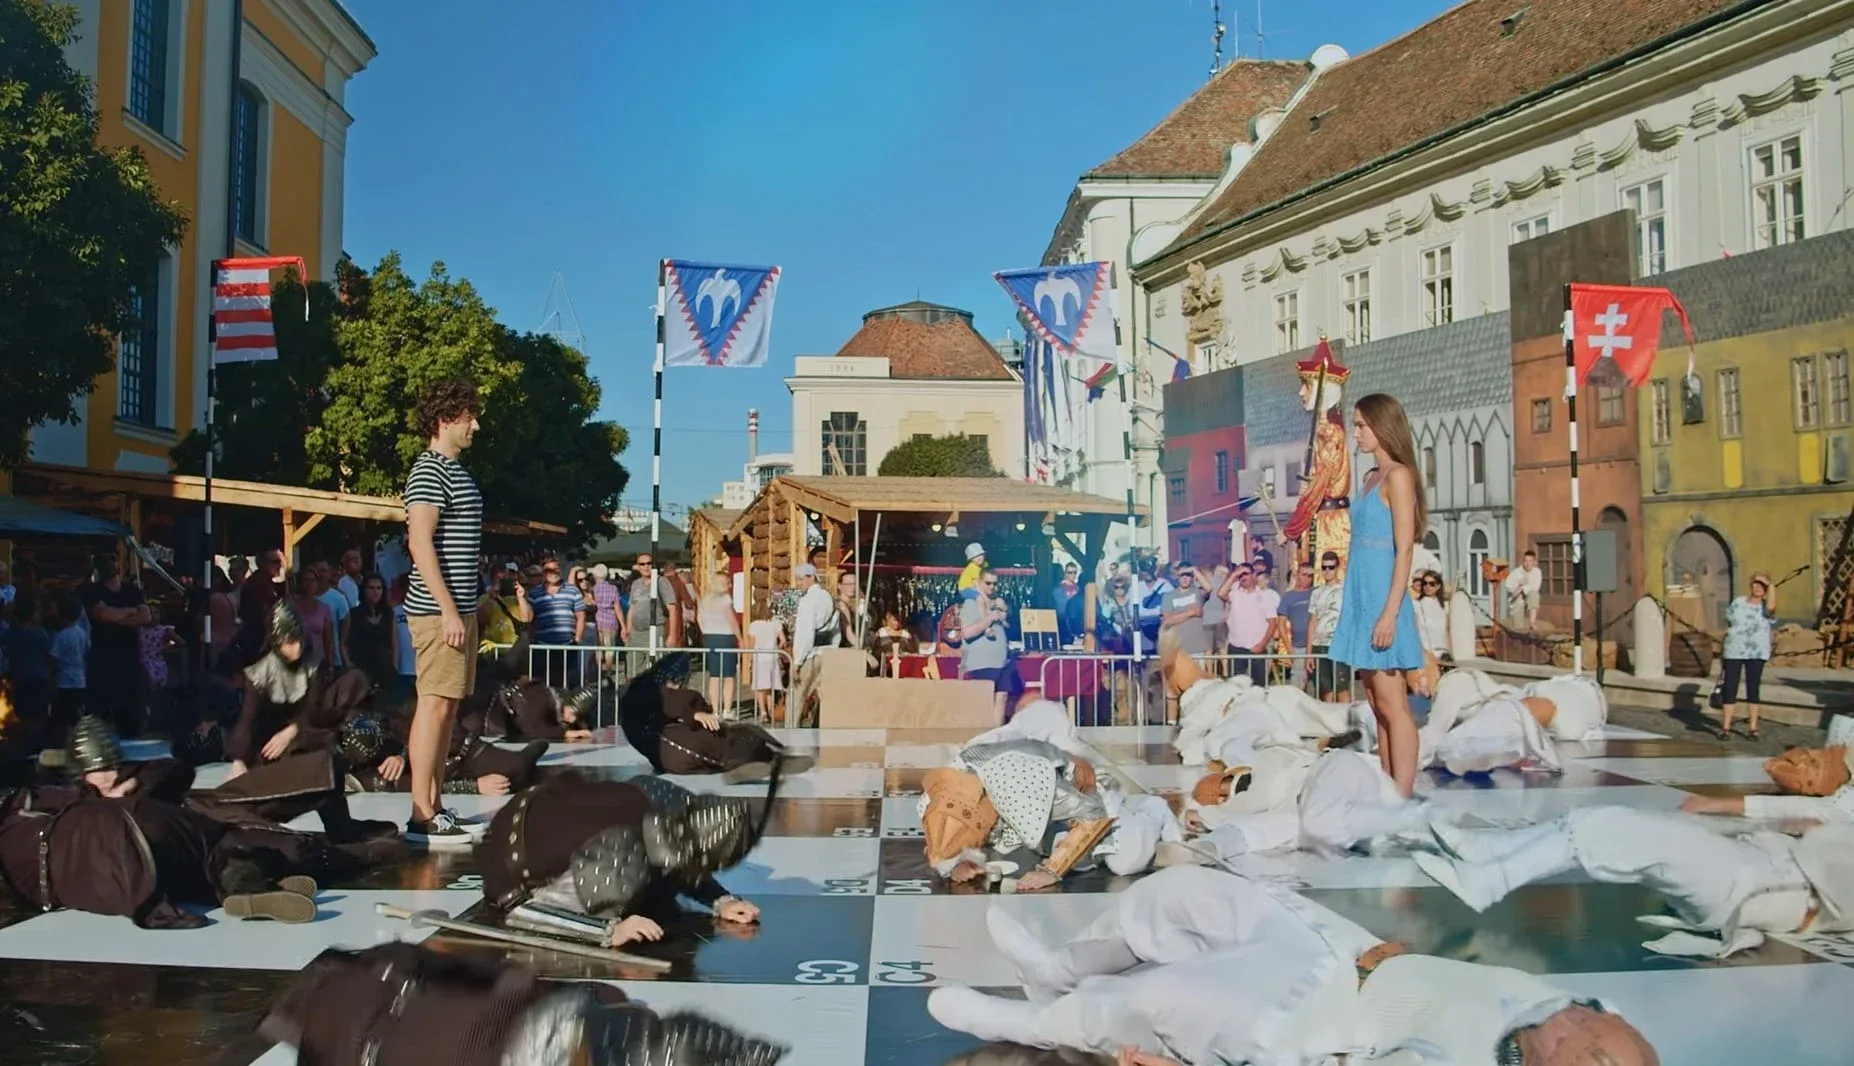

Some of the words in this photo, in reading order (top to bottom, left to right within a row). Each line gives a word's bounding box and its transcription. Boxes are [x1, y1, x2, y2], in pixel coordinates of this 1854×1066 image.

[884, 879, 933, 894] D4
[795, 959, 860, 984] C5
[876, 960, 937, 984] C4
